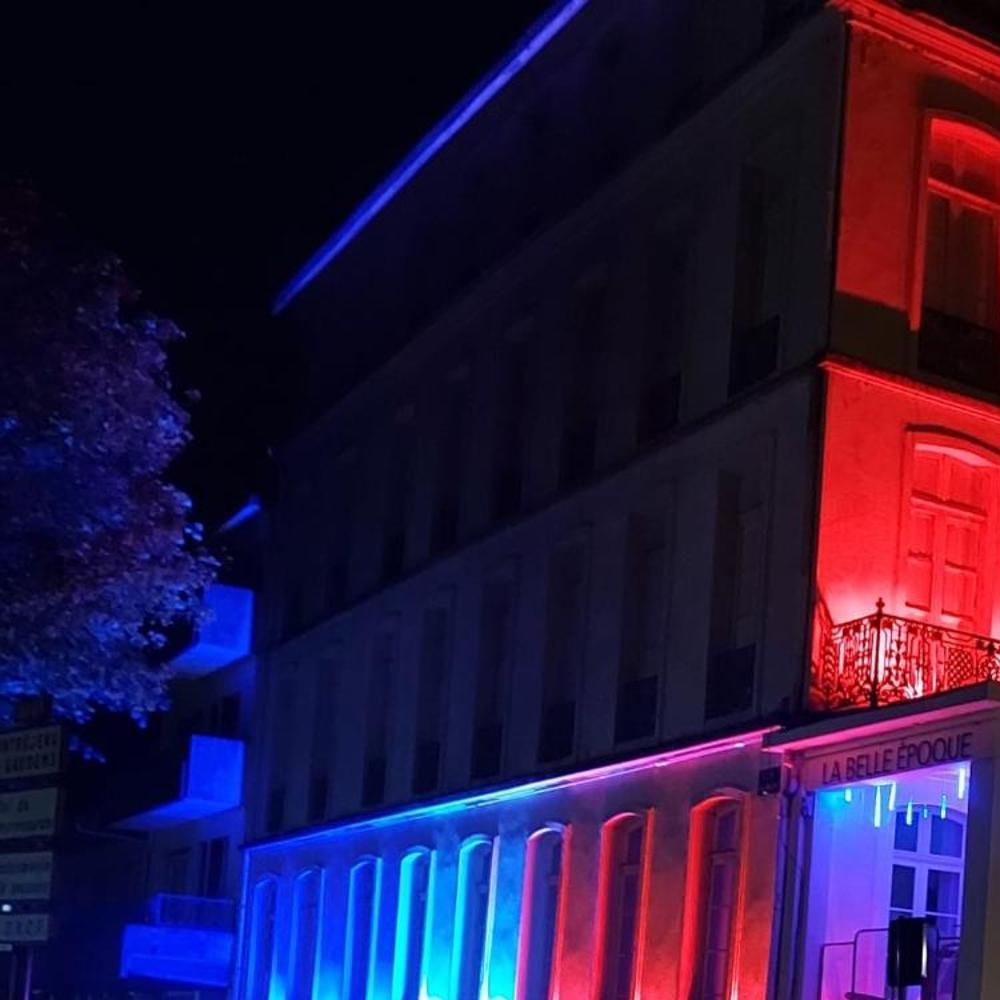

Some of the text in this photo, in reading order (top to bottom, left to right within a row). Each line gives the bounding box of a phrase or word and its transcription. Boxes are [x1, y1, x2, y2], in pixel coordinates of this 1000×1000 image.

[822, 732, 974, 785] LA BELLE ÉPOQUE
